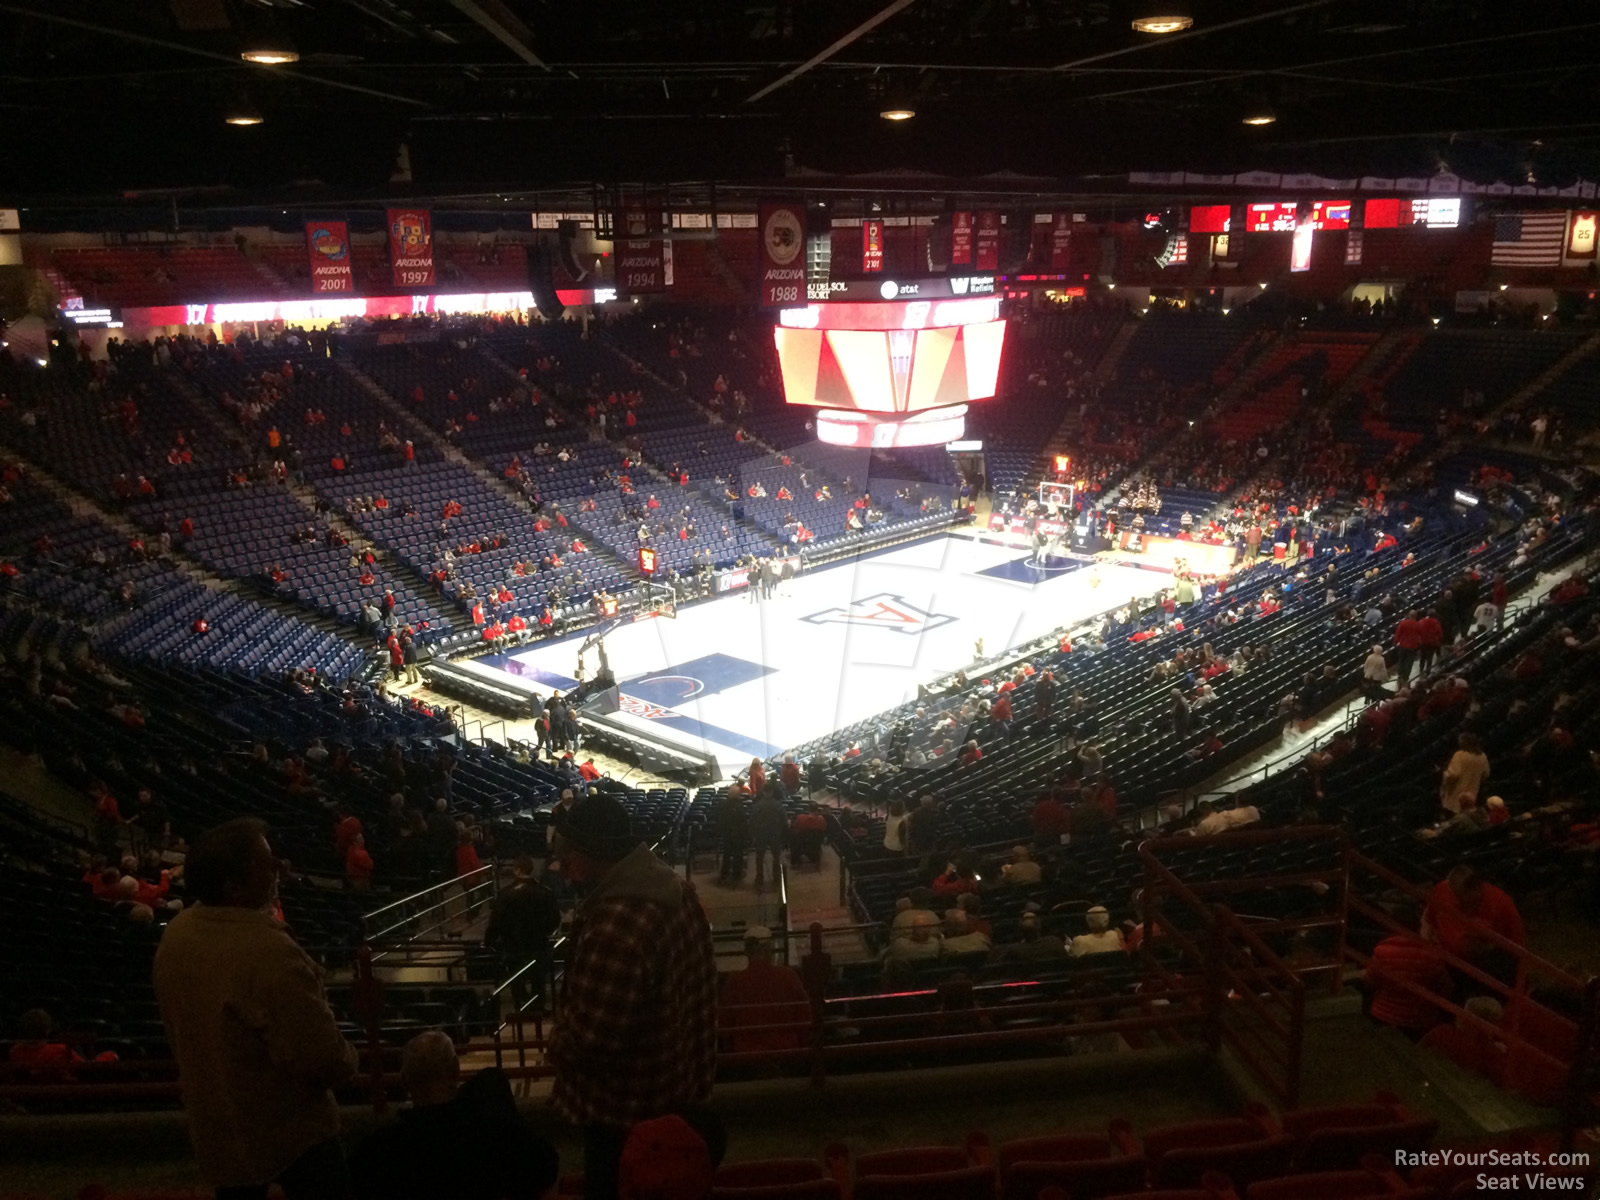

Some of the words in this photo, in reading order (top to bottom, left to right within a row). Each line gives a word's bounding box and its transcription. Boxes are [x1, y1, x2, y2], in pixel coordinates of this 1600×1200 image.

[1578, 229, 1590, 239] 25
[395, 259, 433, 267] ARIZONA
[621, 257, 660, 267] ARIZONA
[315, 267, 351, 275] ARIZONA
[765, 269, 804, 280] ARIZONA
[401, 272, 428, 284] 1997
[628, 273, 655, 287] 1994
[320, 279, 346, 290] 2001
[831, 282, 848, 291] SOL
[900, 284, 919, 293] at&t
[769, 286, 798, 302] 1988
